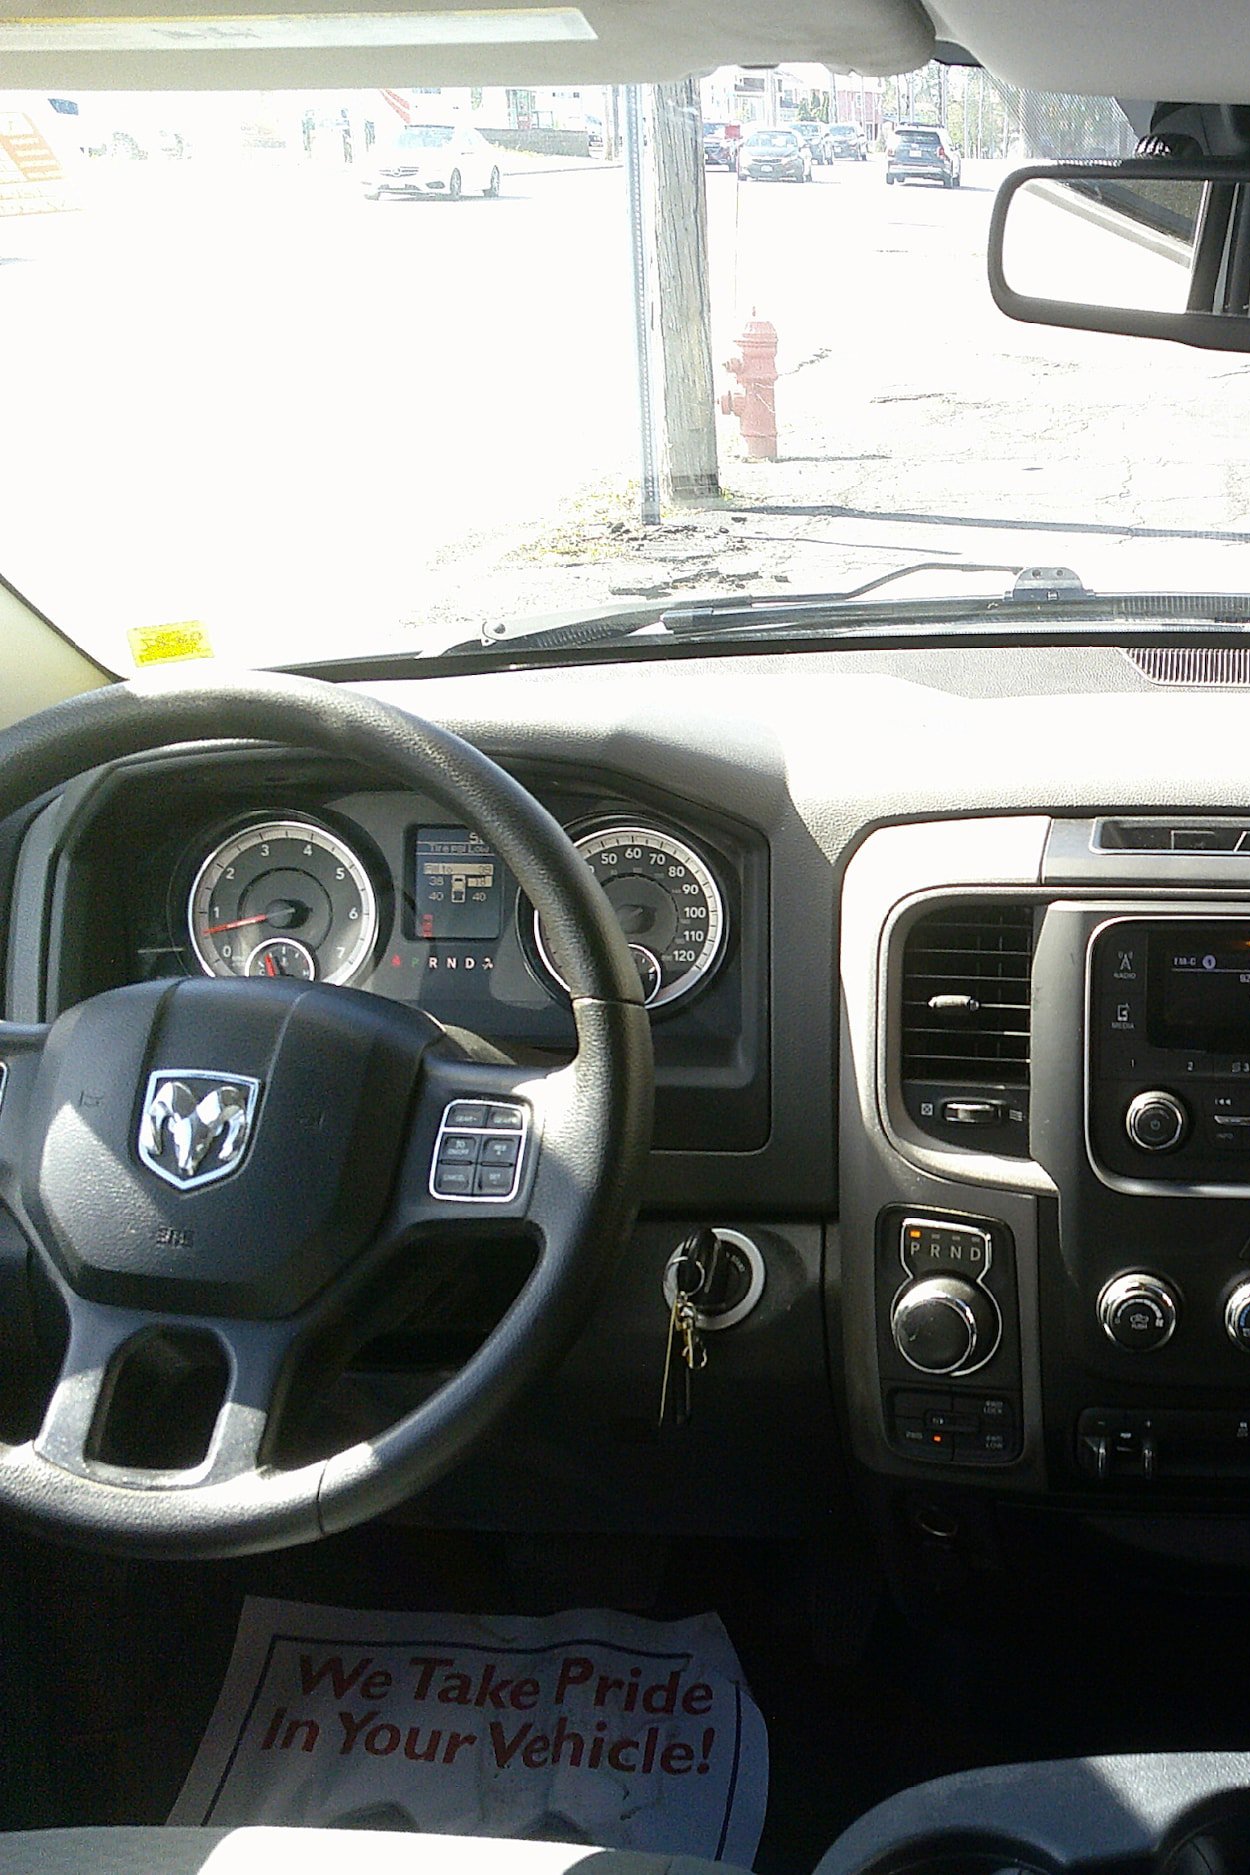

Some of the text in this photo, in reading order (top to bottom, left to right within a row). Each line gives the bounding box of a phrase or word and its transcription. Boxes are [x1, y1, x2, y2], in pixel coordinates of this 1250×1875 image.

[261, 845, 270, 856] 3
[303, 845, 312, 856] 4
[625, 848, 642, 859] 60
[601, 853, 618, 865] 50
[649, 853, 666, 865] 70
[226, 868, 235, 879] 2
[336, 868, 346, 879] 5
[668, 866, 685, 877] 80
[682, 884, 699, 895] 90
[428, 892, 487, 902] 40 40
[213, 907, 220, 918] 1
[349, 907, 358, 919] 6
[684, 906, 706, 918] 100
[683, 931, 704, 942] 110
[223, 946, 232, 957] 0
[336, 947, 346, 959] 7
[673, 950, 695, 961] 120
[429, 956, 438, 969] R
[446, 956, 457, 969] N
[465, 956, 475, 969] D
[1187, 1061, 1194, 1071] 2
[1243, 1062, 1250, 1072] 3
[910, 1242, 981, 1261] P R N D
[300, 1654, 714, 1715] We Take Pride
[261, 1707, 716, 1775] In Your Vehicle!
